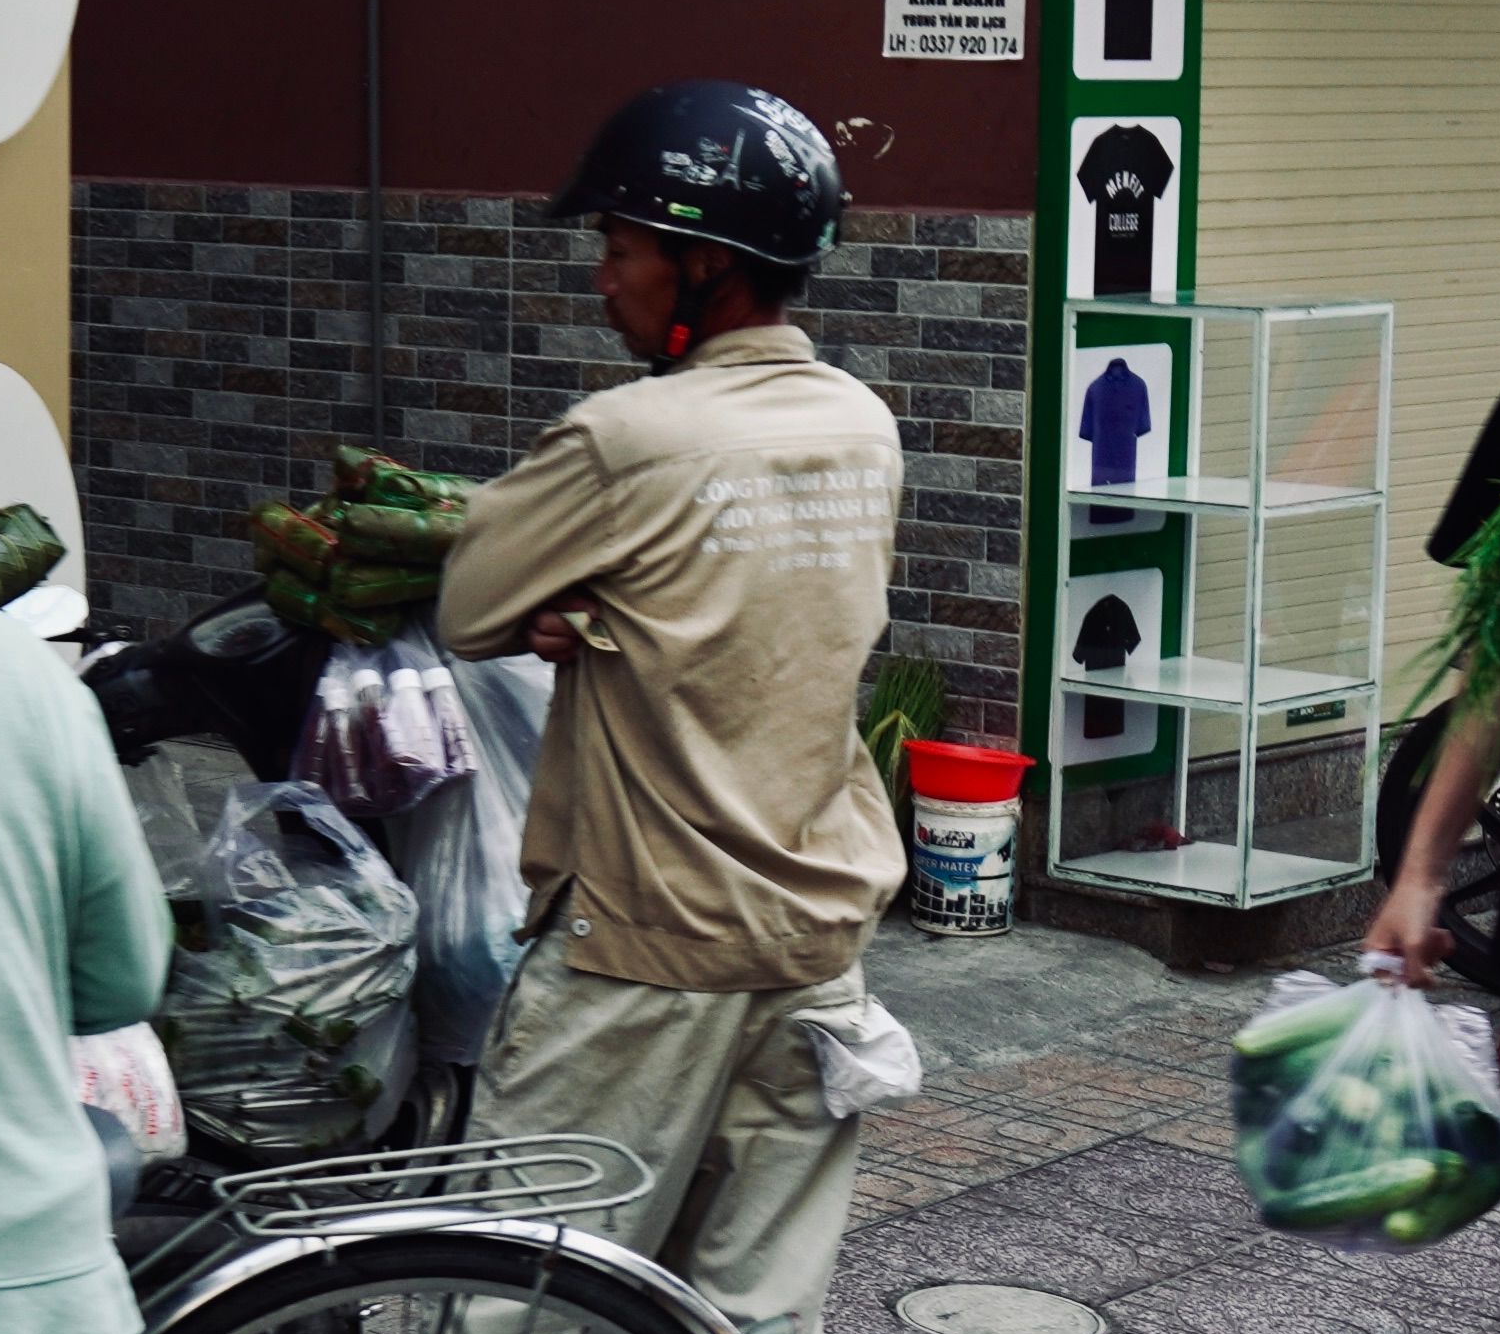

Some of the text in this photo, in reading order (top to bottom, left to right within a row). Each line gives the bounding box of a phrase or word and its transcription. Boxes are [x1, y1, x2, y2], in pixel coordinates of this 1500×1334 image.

[889, 34, 907, 52] LH
[919, 35, 955, 54] 0337
[959, 35, 987, 55] 920
[992, 37, 1018, 55] 174
